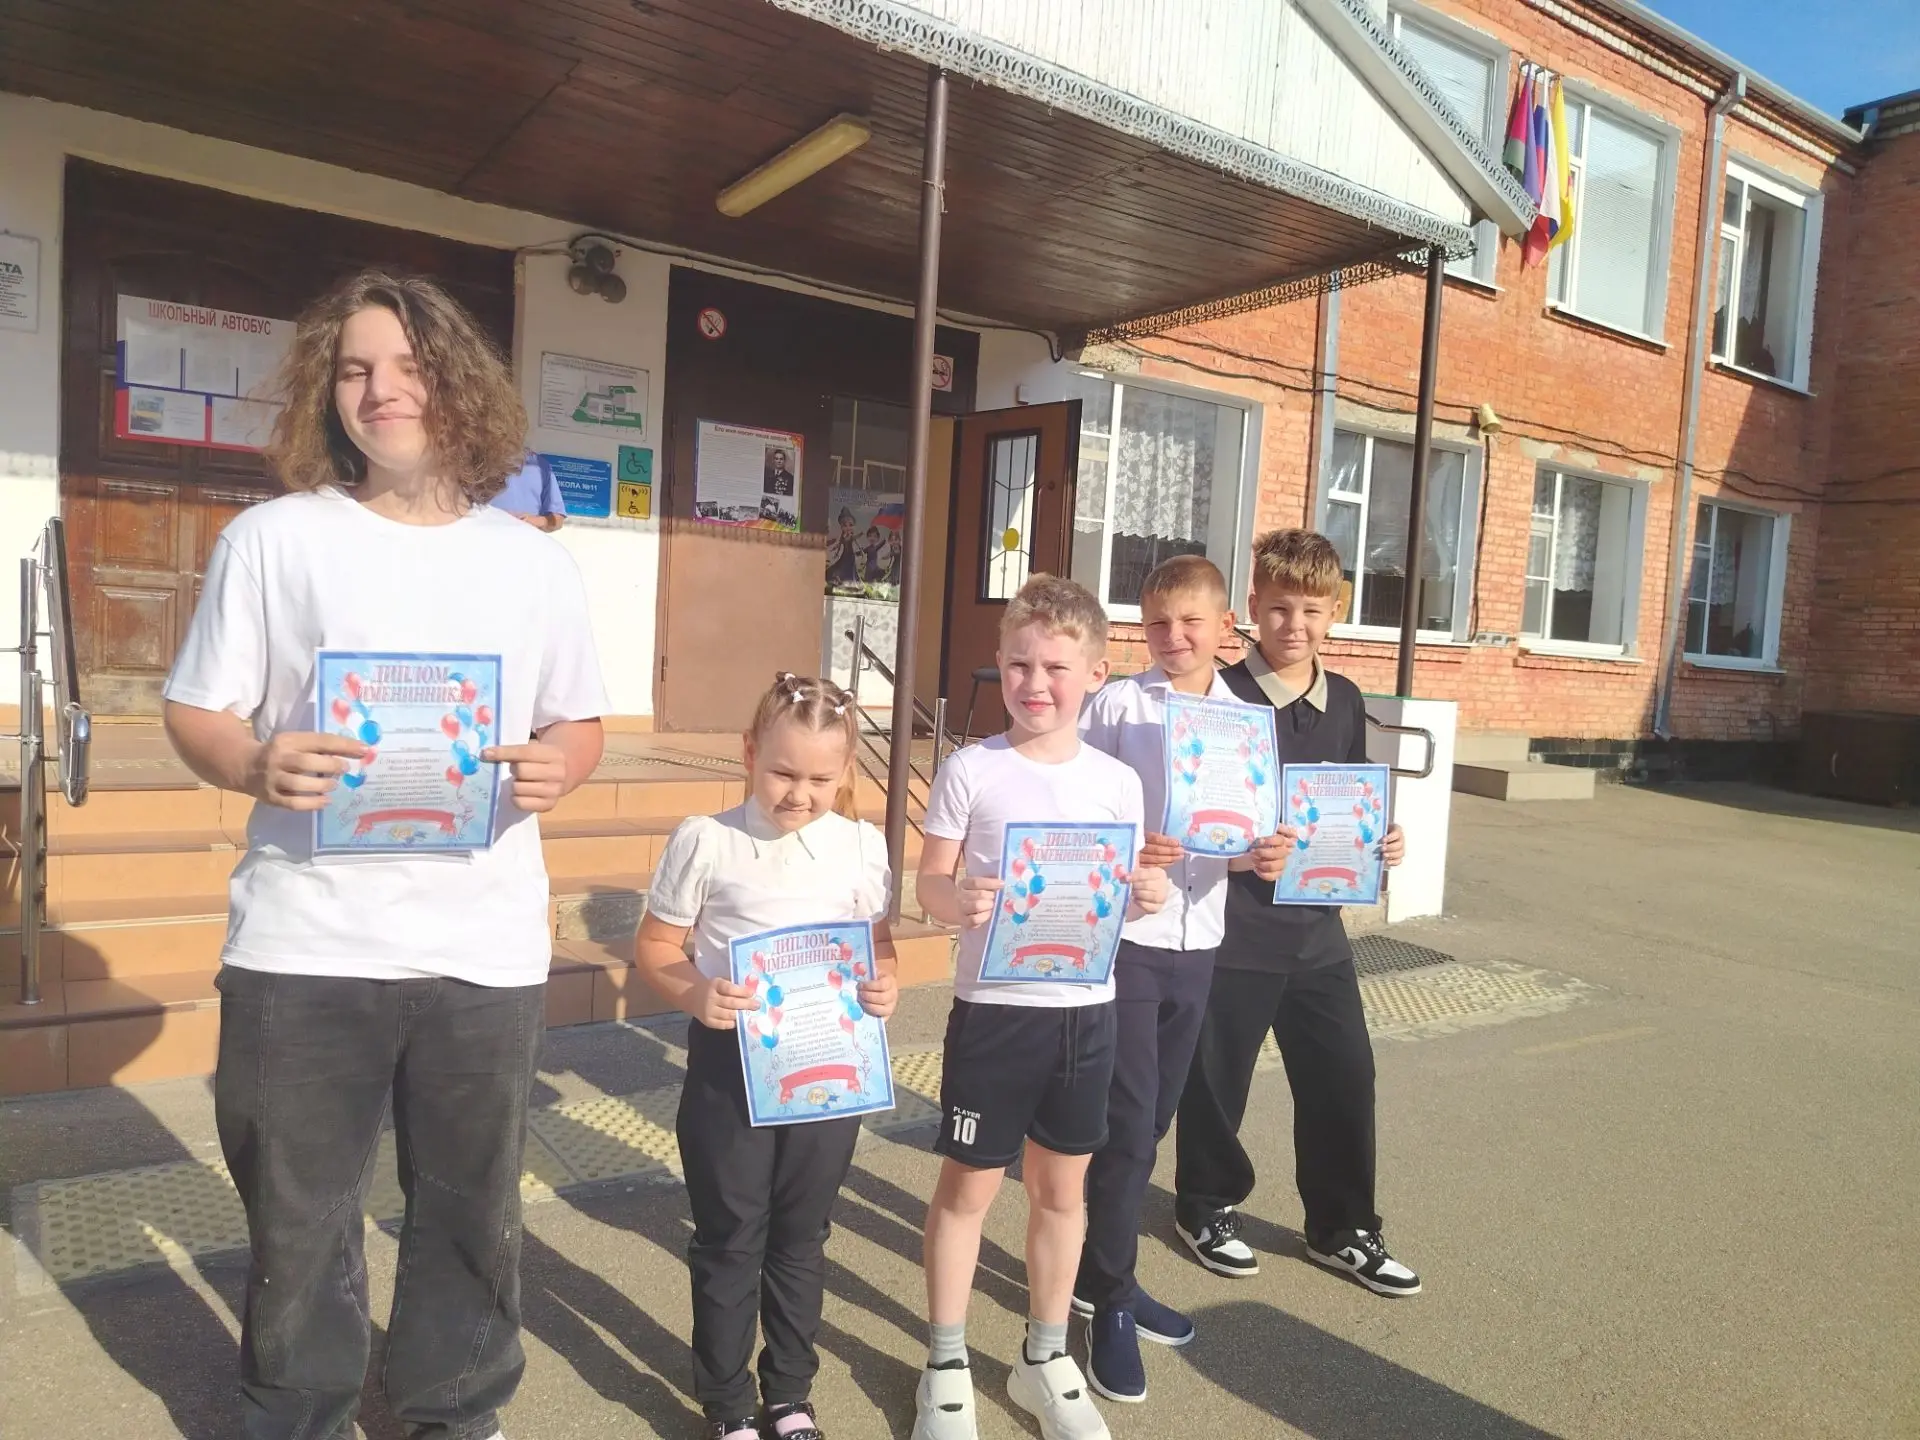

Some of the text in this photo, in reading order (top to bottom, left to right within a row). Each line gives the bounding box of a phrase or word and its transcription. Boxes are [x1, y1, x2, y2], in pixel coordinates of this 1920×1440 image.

[148, 301, 271, 336] ШКОЛЬНЫЙ АВТОБУС
[558, 481, 581, 489] КОЛА
[371, 665, 450, 684] ДИПЛОМ
[1312, 773, 1357, 785] ДИПЛОМ
[1041, 832, 1098, 847] ДИПЛОМ
[772, 933, 829, 955] ДИПЛОМ
[953, 1105, 981, 1120] PLAYER
[953, 1114, 977, 1145] 10
